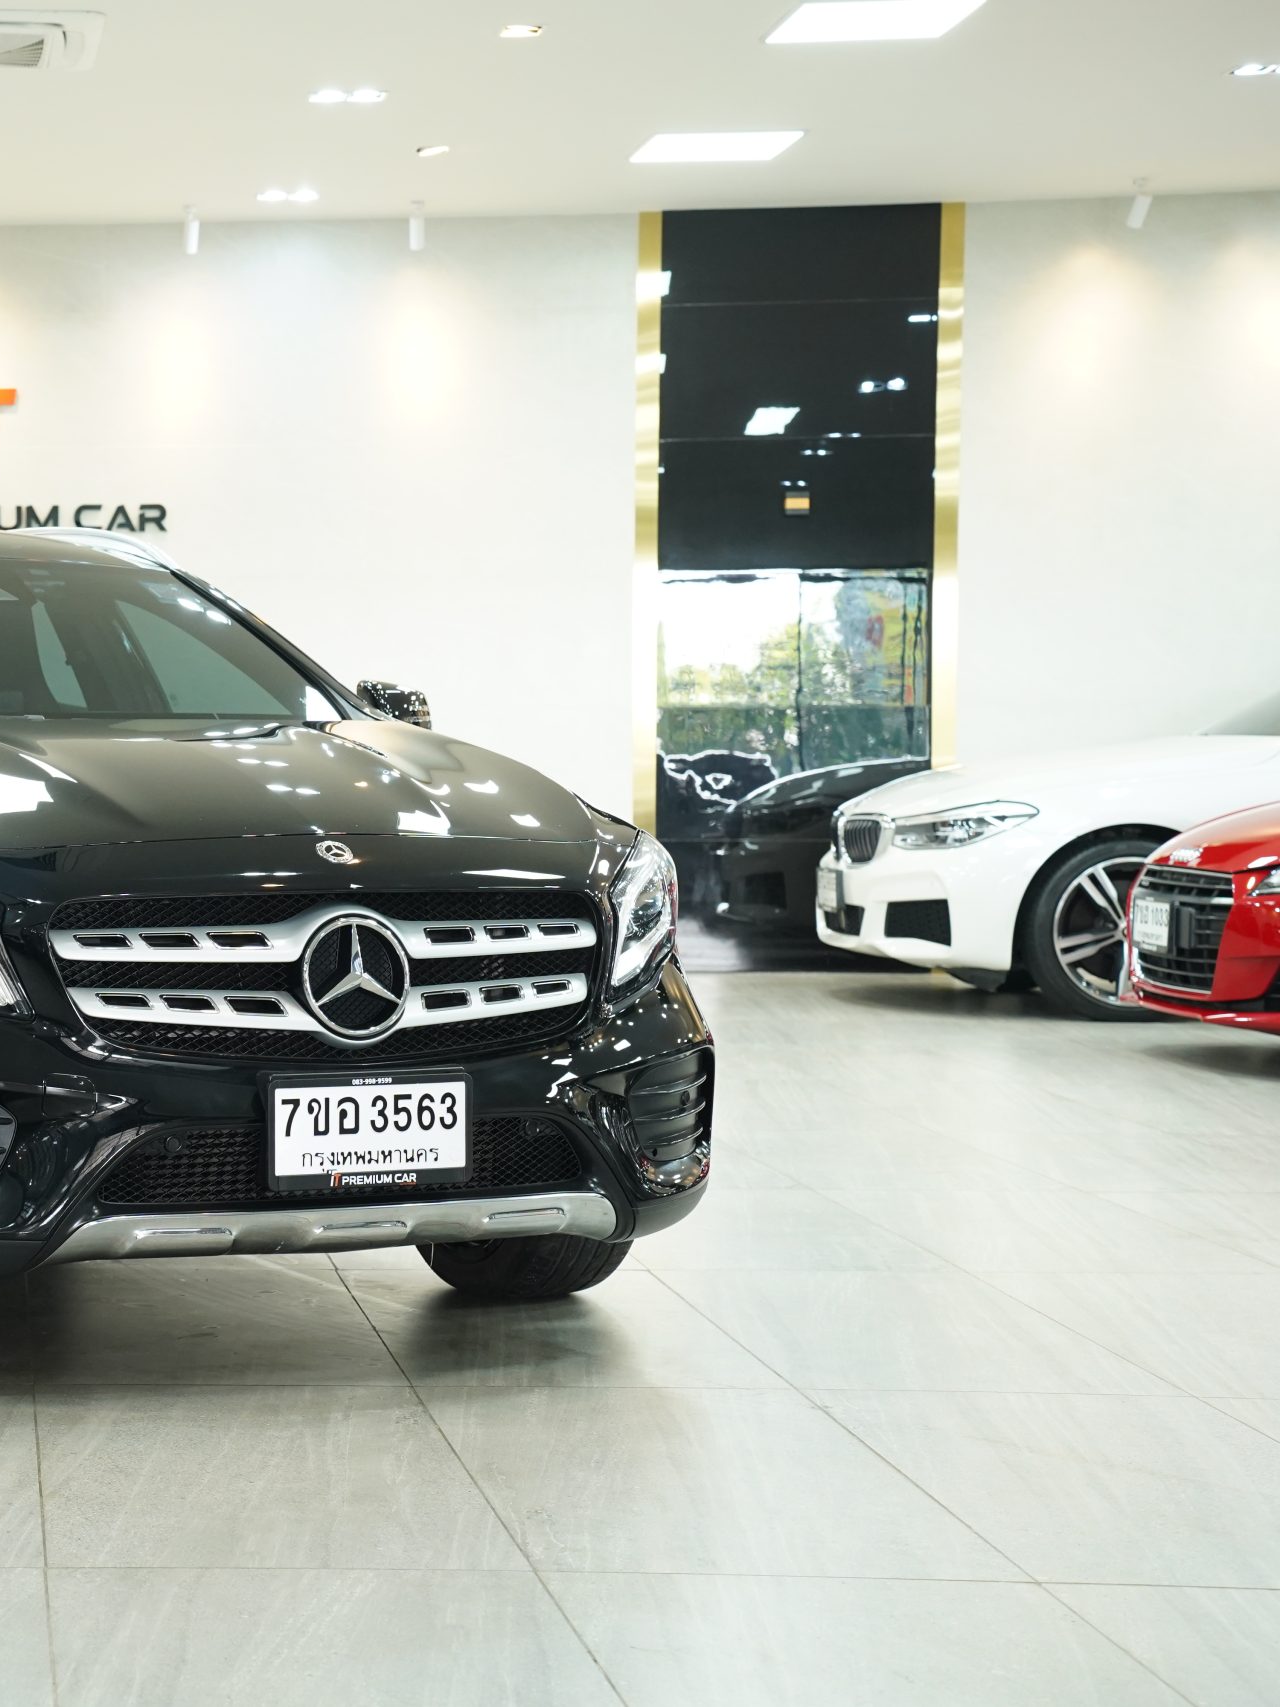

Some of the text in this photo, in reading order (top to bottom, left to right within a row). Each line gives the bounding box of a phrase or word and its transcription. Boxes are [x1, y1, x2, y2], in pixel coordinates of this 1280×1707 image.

[74, 504, 167, 532] CAR
[281, 1092, 458, 1137] 7ขอ 3563
[302, 1147, 439, 1172] กรุงเทพมหานคร
[342, 1173, 393, 1186] PREMIUM
[394, 1172, 417, 1183] CAR
